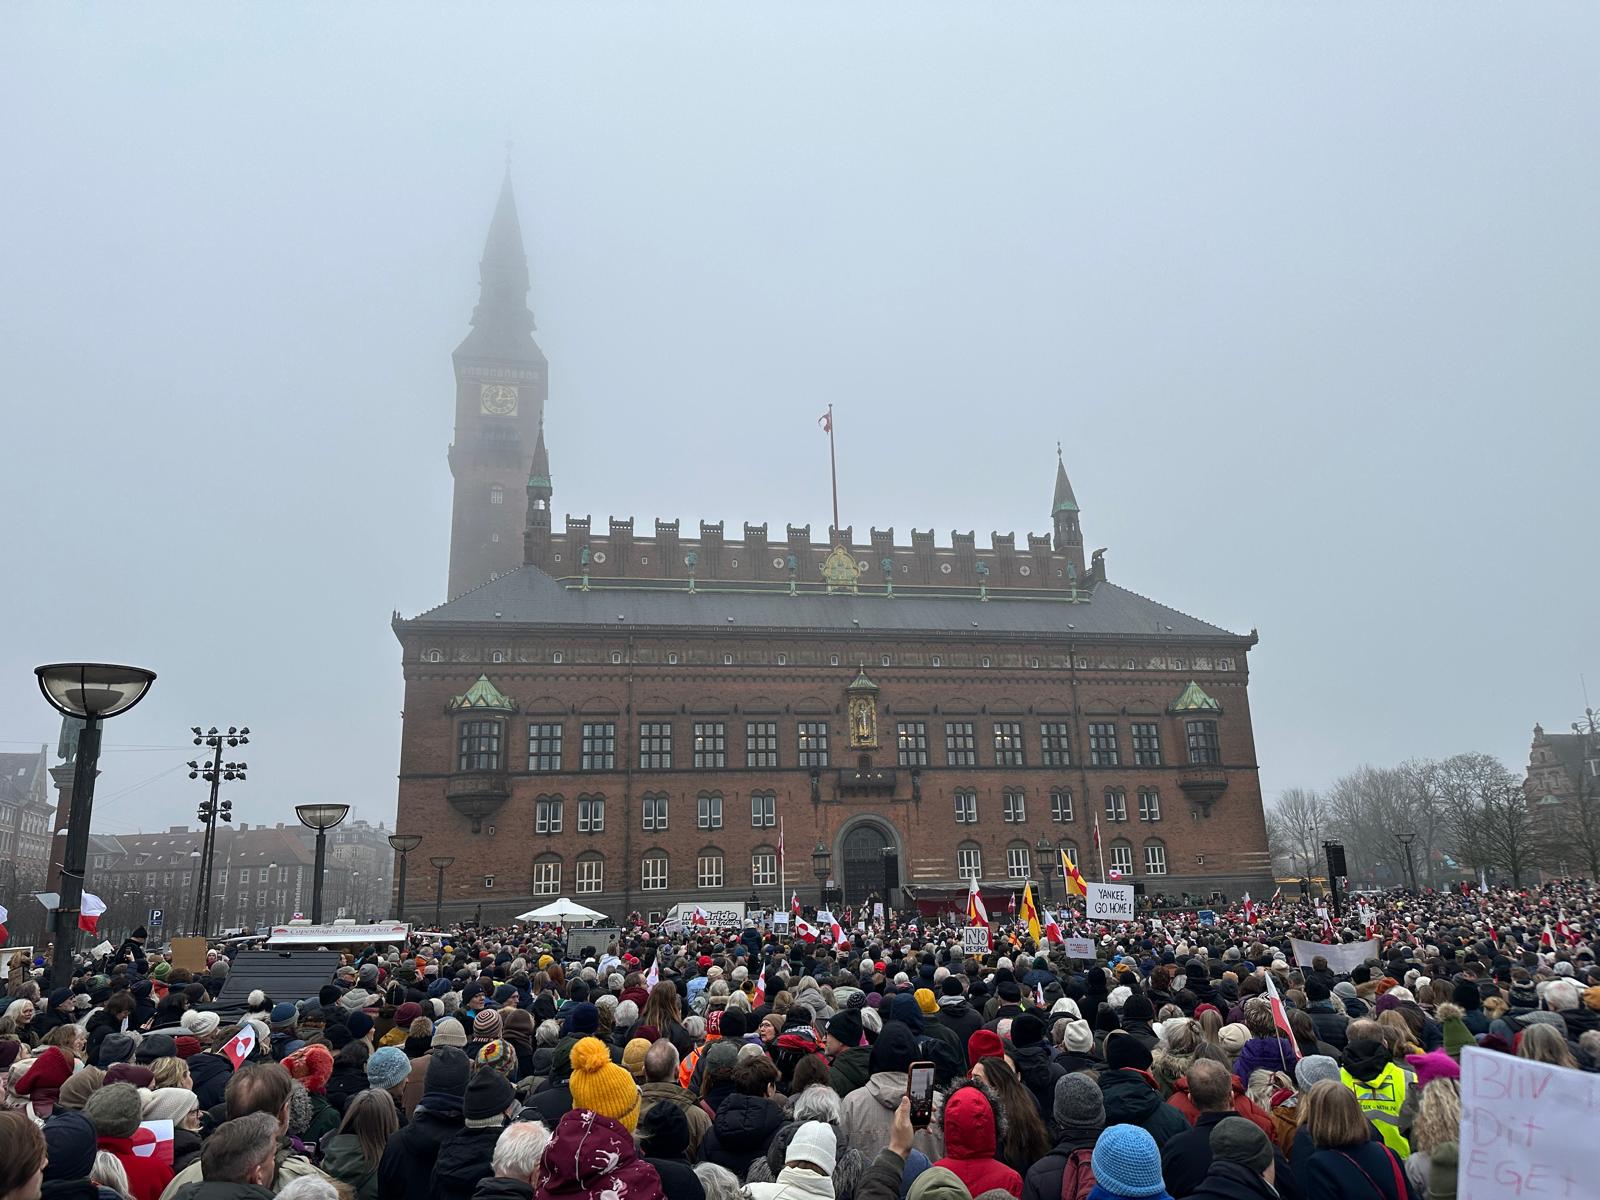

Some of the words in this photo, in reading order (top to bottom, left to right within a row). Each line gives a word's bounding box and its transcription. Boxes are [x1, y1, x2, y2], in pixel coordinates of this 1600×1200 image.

[1098, 889, 1127, 901] YANKEE,
[1095, 903, 1107, 914] GO
[153, 911, 161, 920] P
[966, 929, 988, 945] NO
